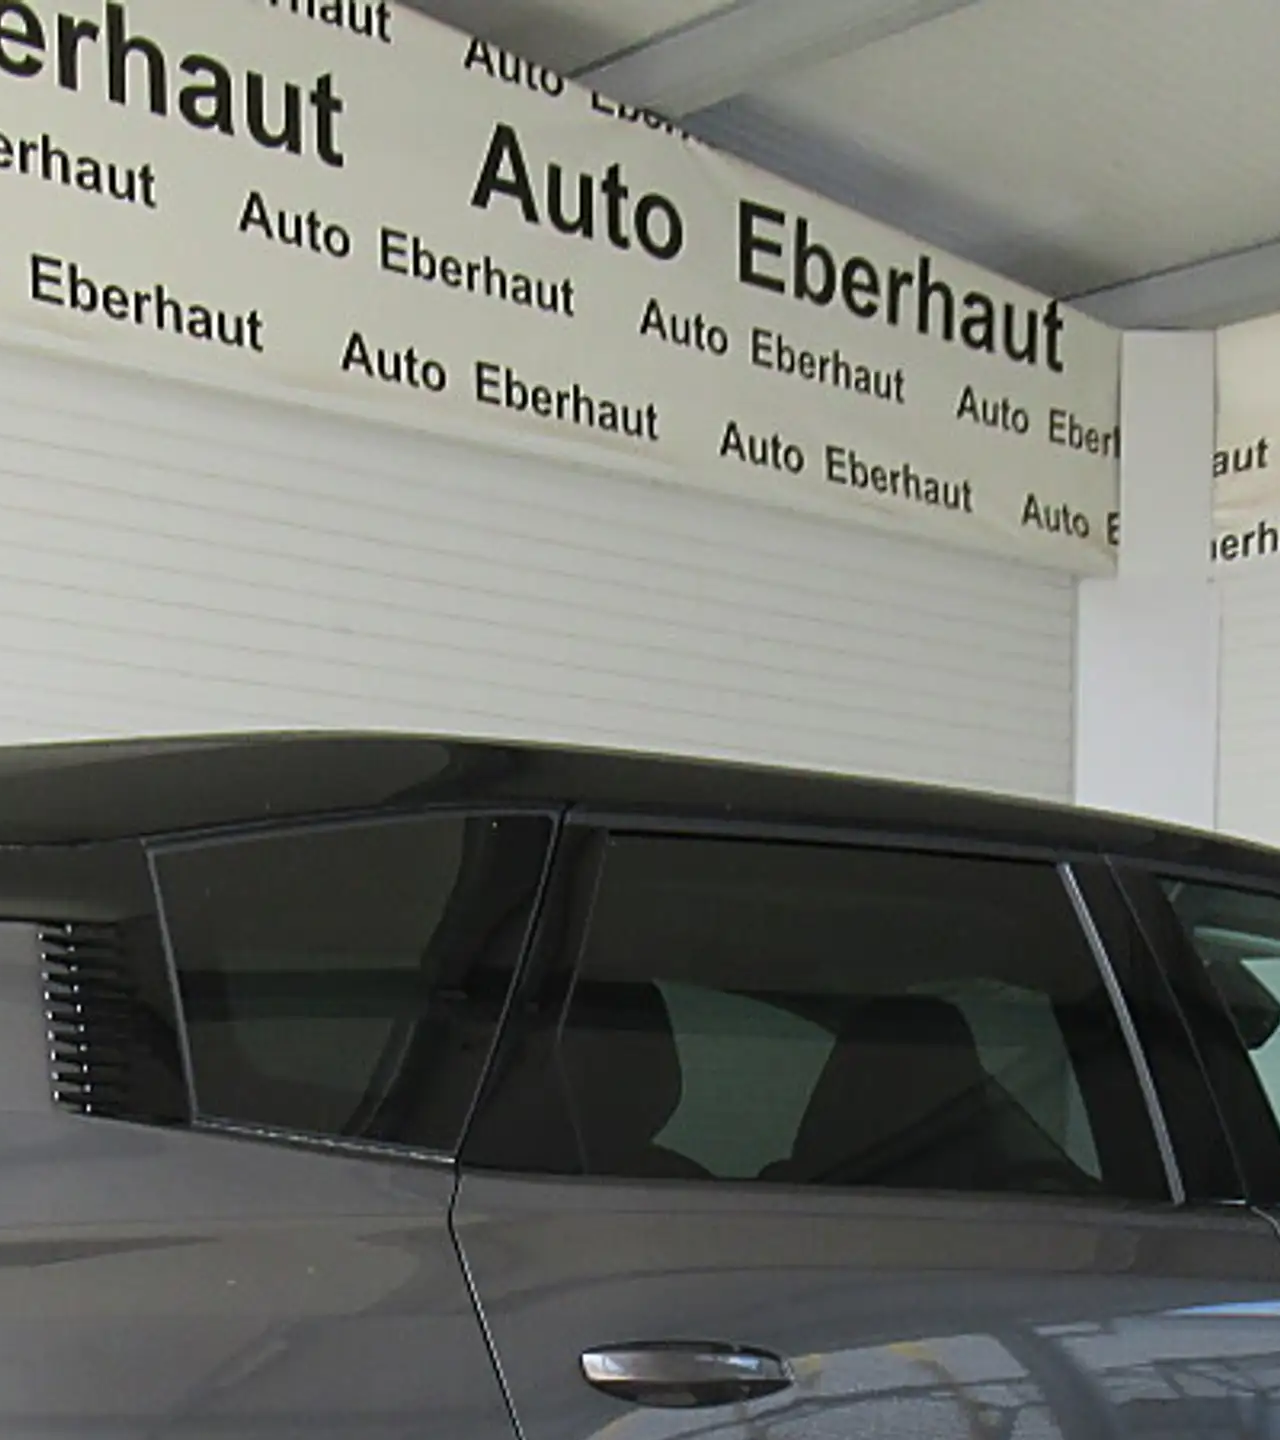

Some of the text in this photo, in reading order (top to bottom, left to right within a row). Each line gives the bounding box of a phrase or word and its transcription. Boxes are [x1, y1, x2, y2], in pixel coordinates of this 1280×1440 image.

[238, 190, 575, 319] Auto Eberhaut
[469, 121, 1065, 372] Auto Eberhaut
[30, 252, 265, 354] Eberhaut
[638, 296, 906, 406] Auto Eberhaut
[340, 330, 660, 443] Auto Eberhaut
[955, 383, 1031, 436] Auto
[718, 419, 974, 515] Auto Eberhaut
[1020, 492, 1091, 540] Auto
